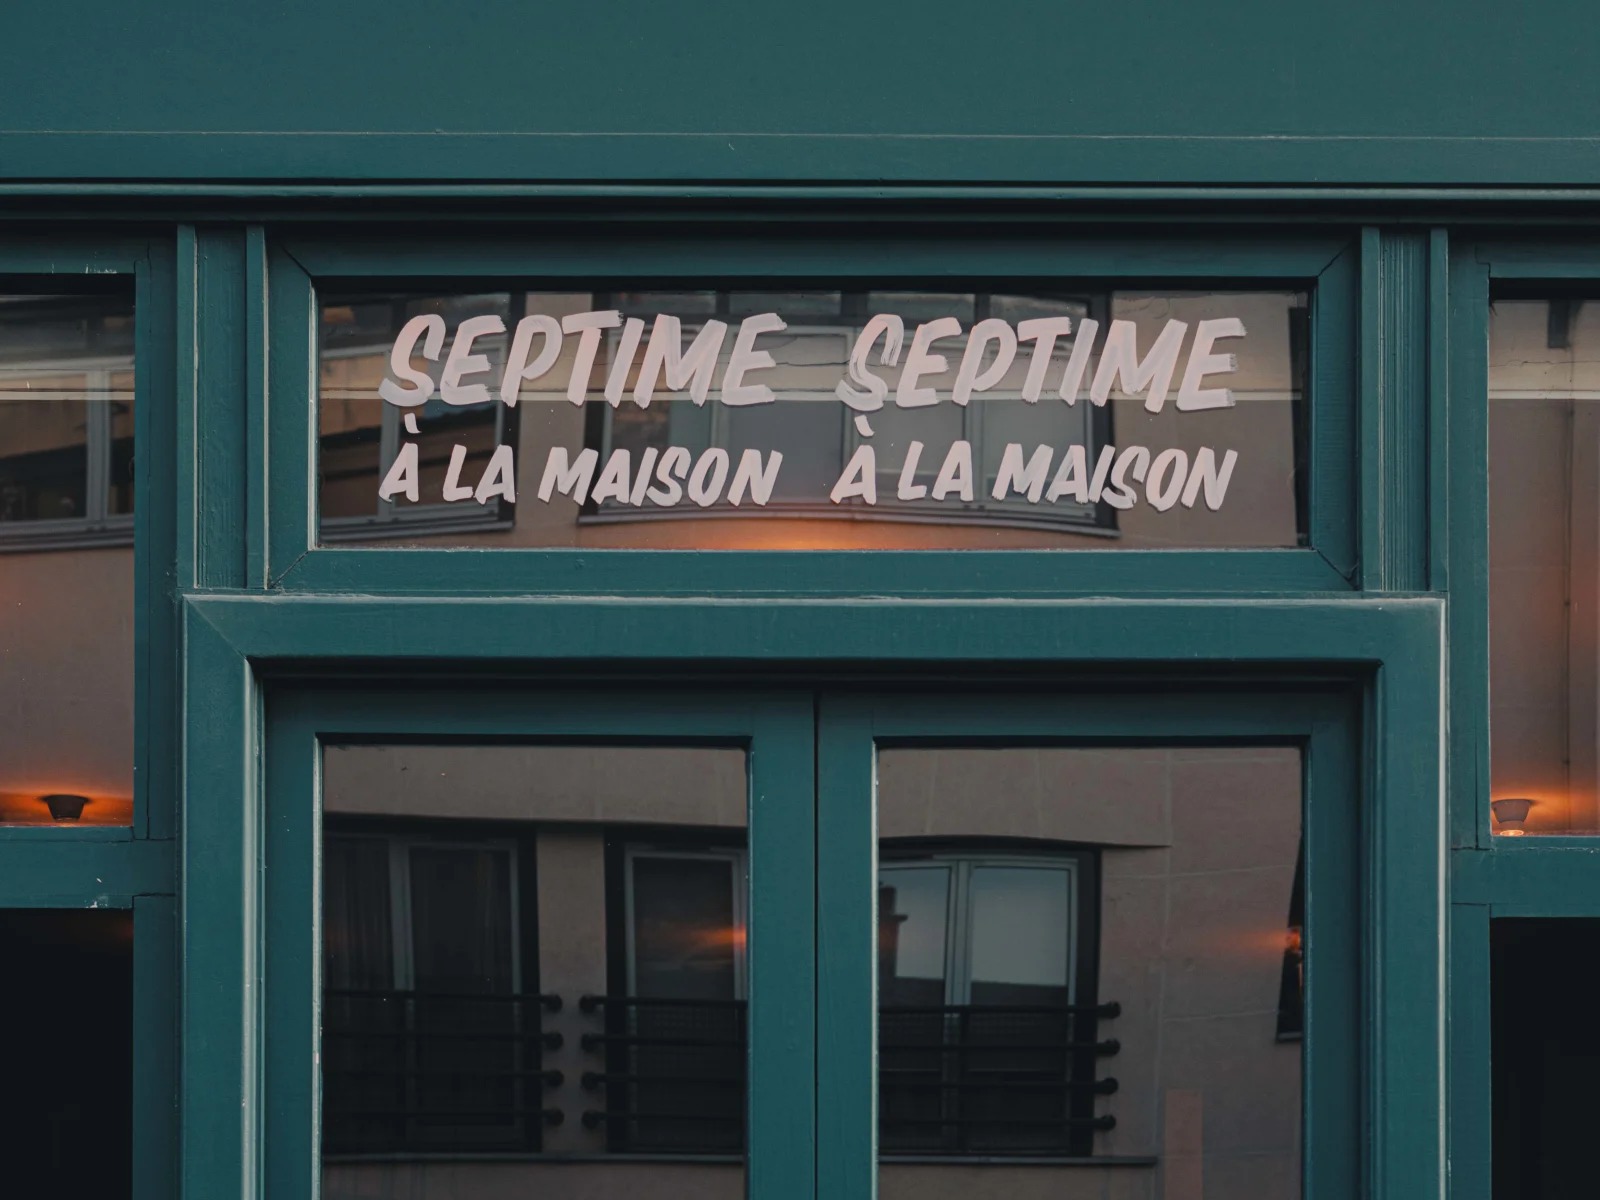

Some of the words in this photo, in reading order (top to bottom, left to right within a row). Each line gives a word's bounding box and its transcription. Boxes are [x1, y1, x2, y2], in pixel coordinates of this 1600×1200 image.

[379, 310, 787, 409] SEPTIME
[834, 312, 1248, 413] SEPTIME
[378, 413, 419, 502] À
[442, 444, 516, 505] LA
[537, 446, 784, 508] MAISON
[829, 415, 877, 505] À
[897, 440, 974, 502] LA
[991, 442, 1238, 512] MAISON
